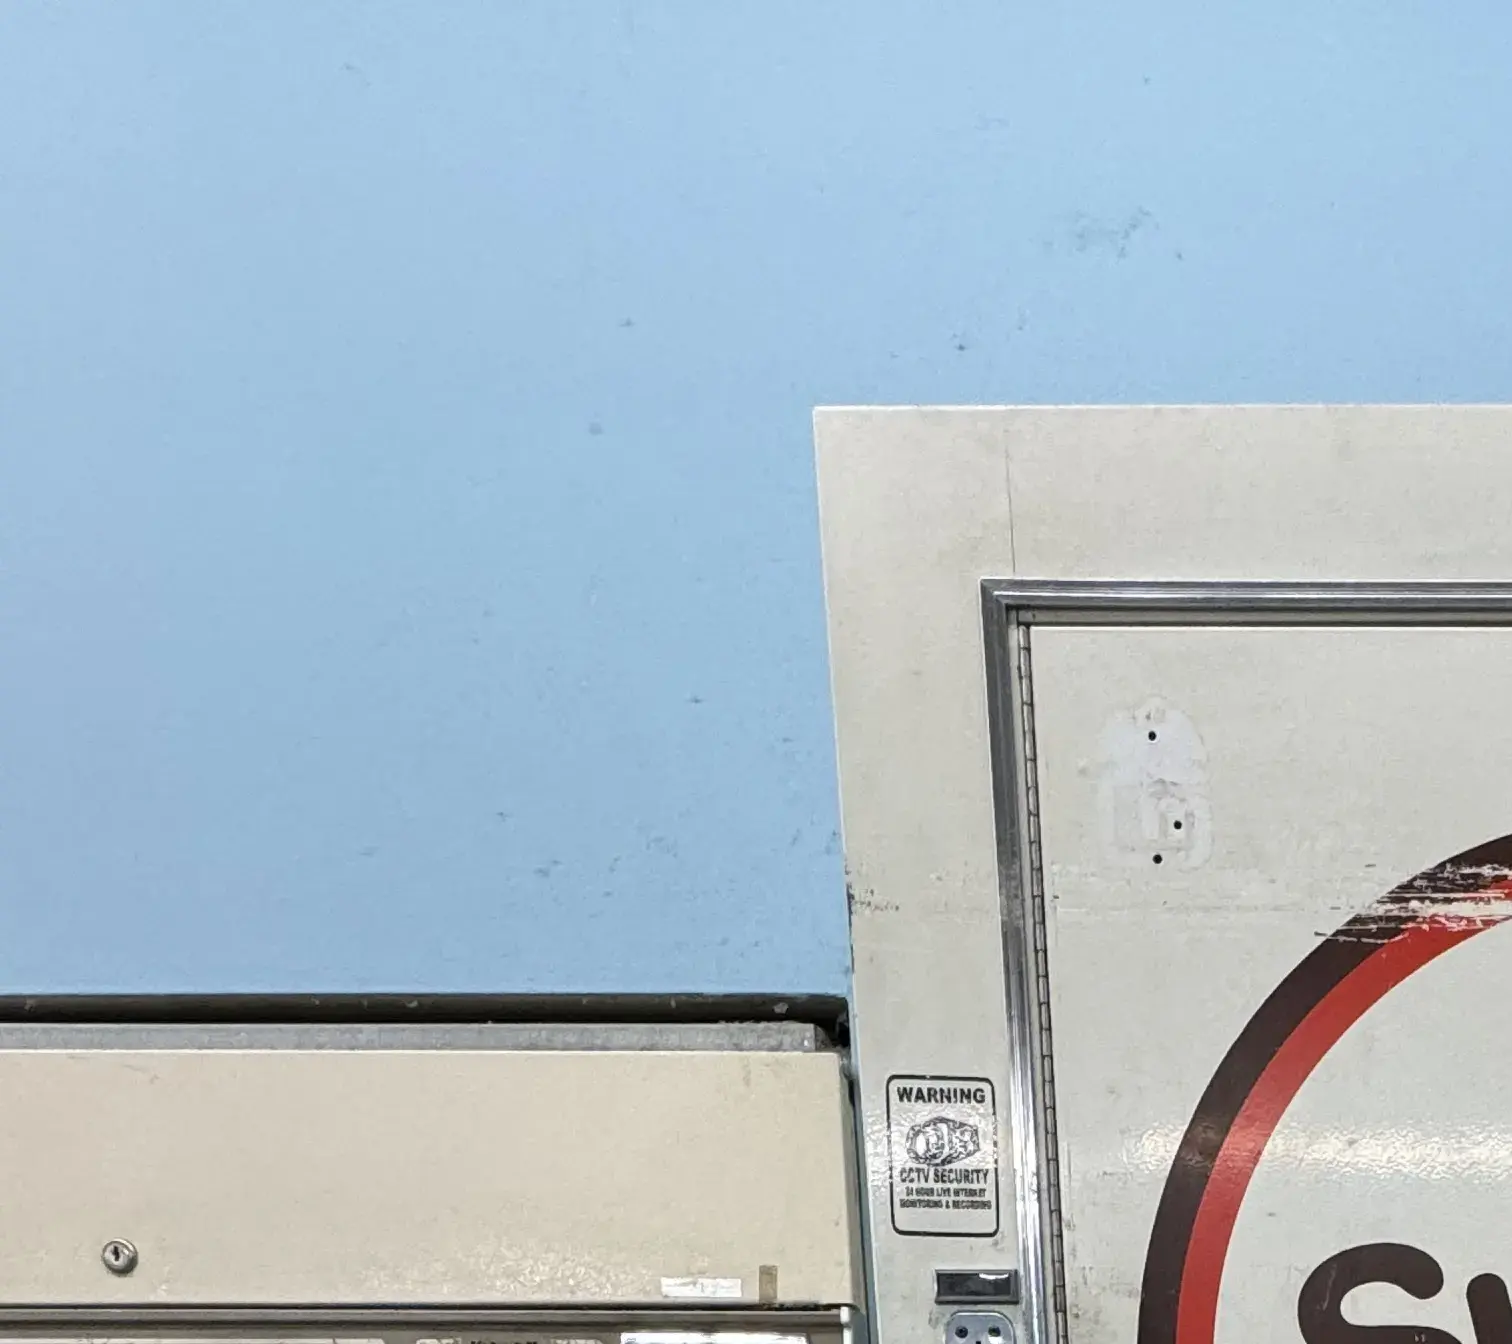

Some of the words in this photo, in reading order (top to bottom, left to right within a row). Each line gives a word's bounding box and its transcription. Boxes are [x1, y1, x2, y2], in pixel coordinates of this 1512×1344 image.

[897, 1086, 986, 1104] WARNING
[900, 1167, 929, 1183] CCTV
[933, 1168, 989, 1184] SECURITY
